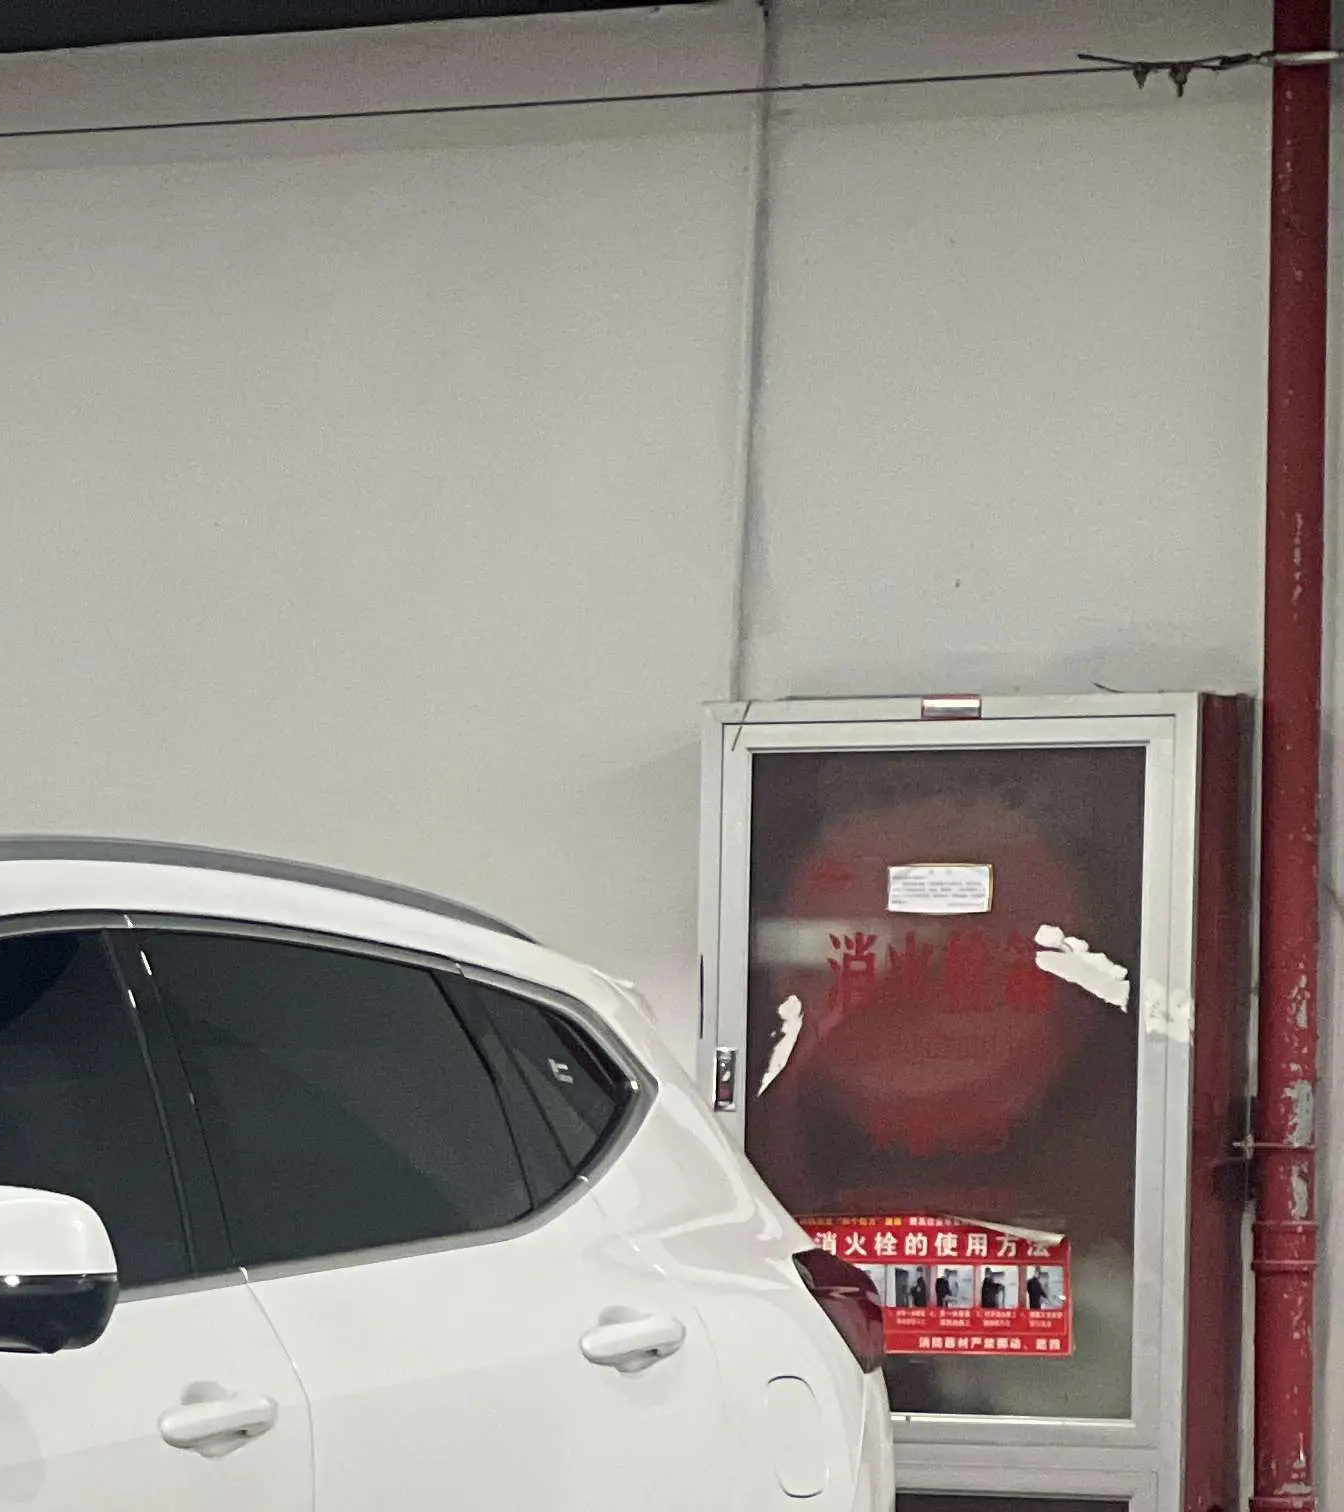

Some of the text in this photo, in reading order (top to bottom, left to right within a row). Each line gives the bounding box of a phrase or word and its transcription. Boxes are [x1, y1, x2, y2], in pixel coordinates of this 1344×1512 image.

[814, 1230, 1051, 1257] 消火栓的使用方法
